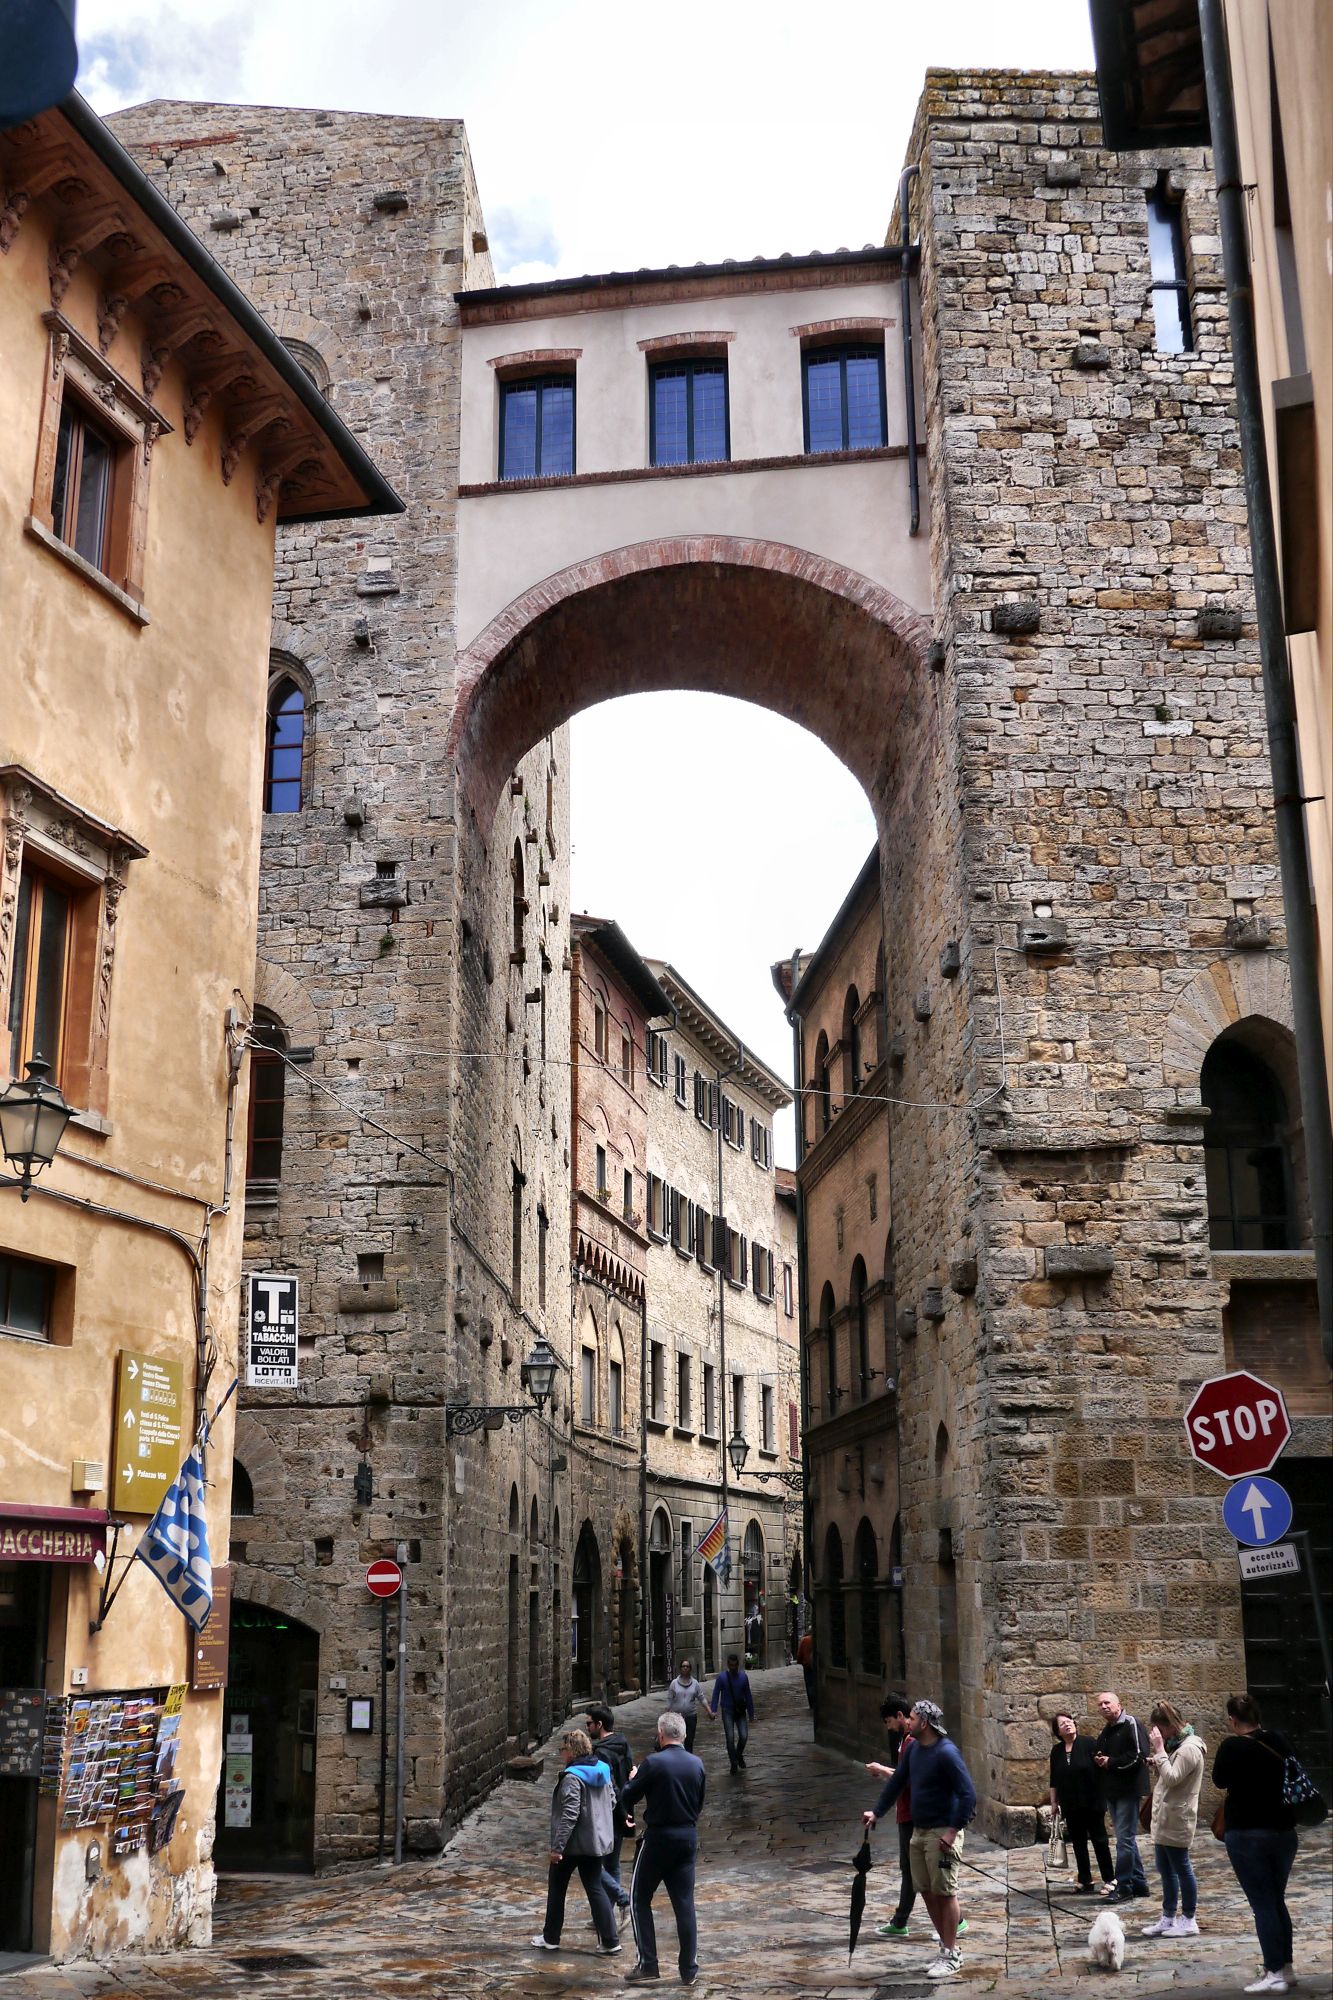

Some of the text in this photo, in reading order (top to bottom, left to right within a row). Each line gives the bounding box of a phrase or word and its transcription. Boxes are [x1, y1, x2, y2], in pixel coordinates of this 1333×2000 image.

[258, 1281, 290, 1323] T
[262, 1325, 279, 1333] SALI
[252, 1332, 295, 1343] TABACCHI
[259, 1347, 288, 1356] VALORI
[257, 1355, 290, 1364] BOLLATI
[255, 1367, 291, 1376] LOTTO
[1193, 1399, 1278, 1451] STOP
[137, 1470, 156, 1479] Palazzo
[0, 1528, 93, 1557] ACCHERIA
[1250, 1550, 1285, 1562] eccetto
[1246, 1559, 1294, 1574] autorizzati
[665, 1628, 673, 1681] FASHION
